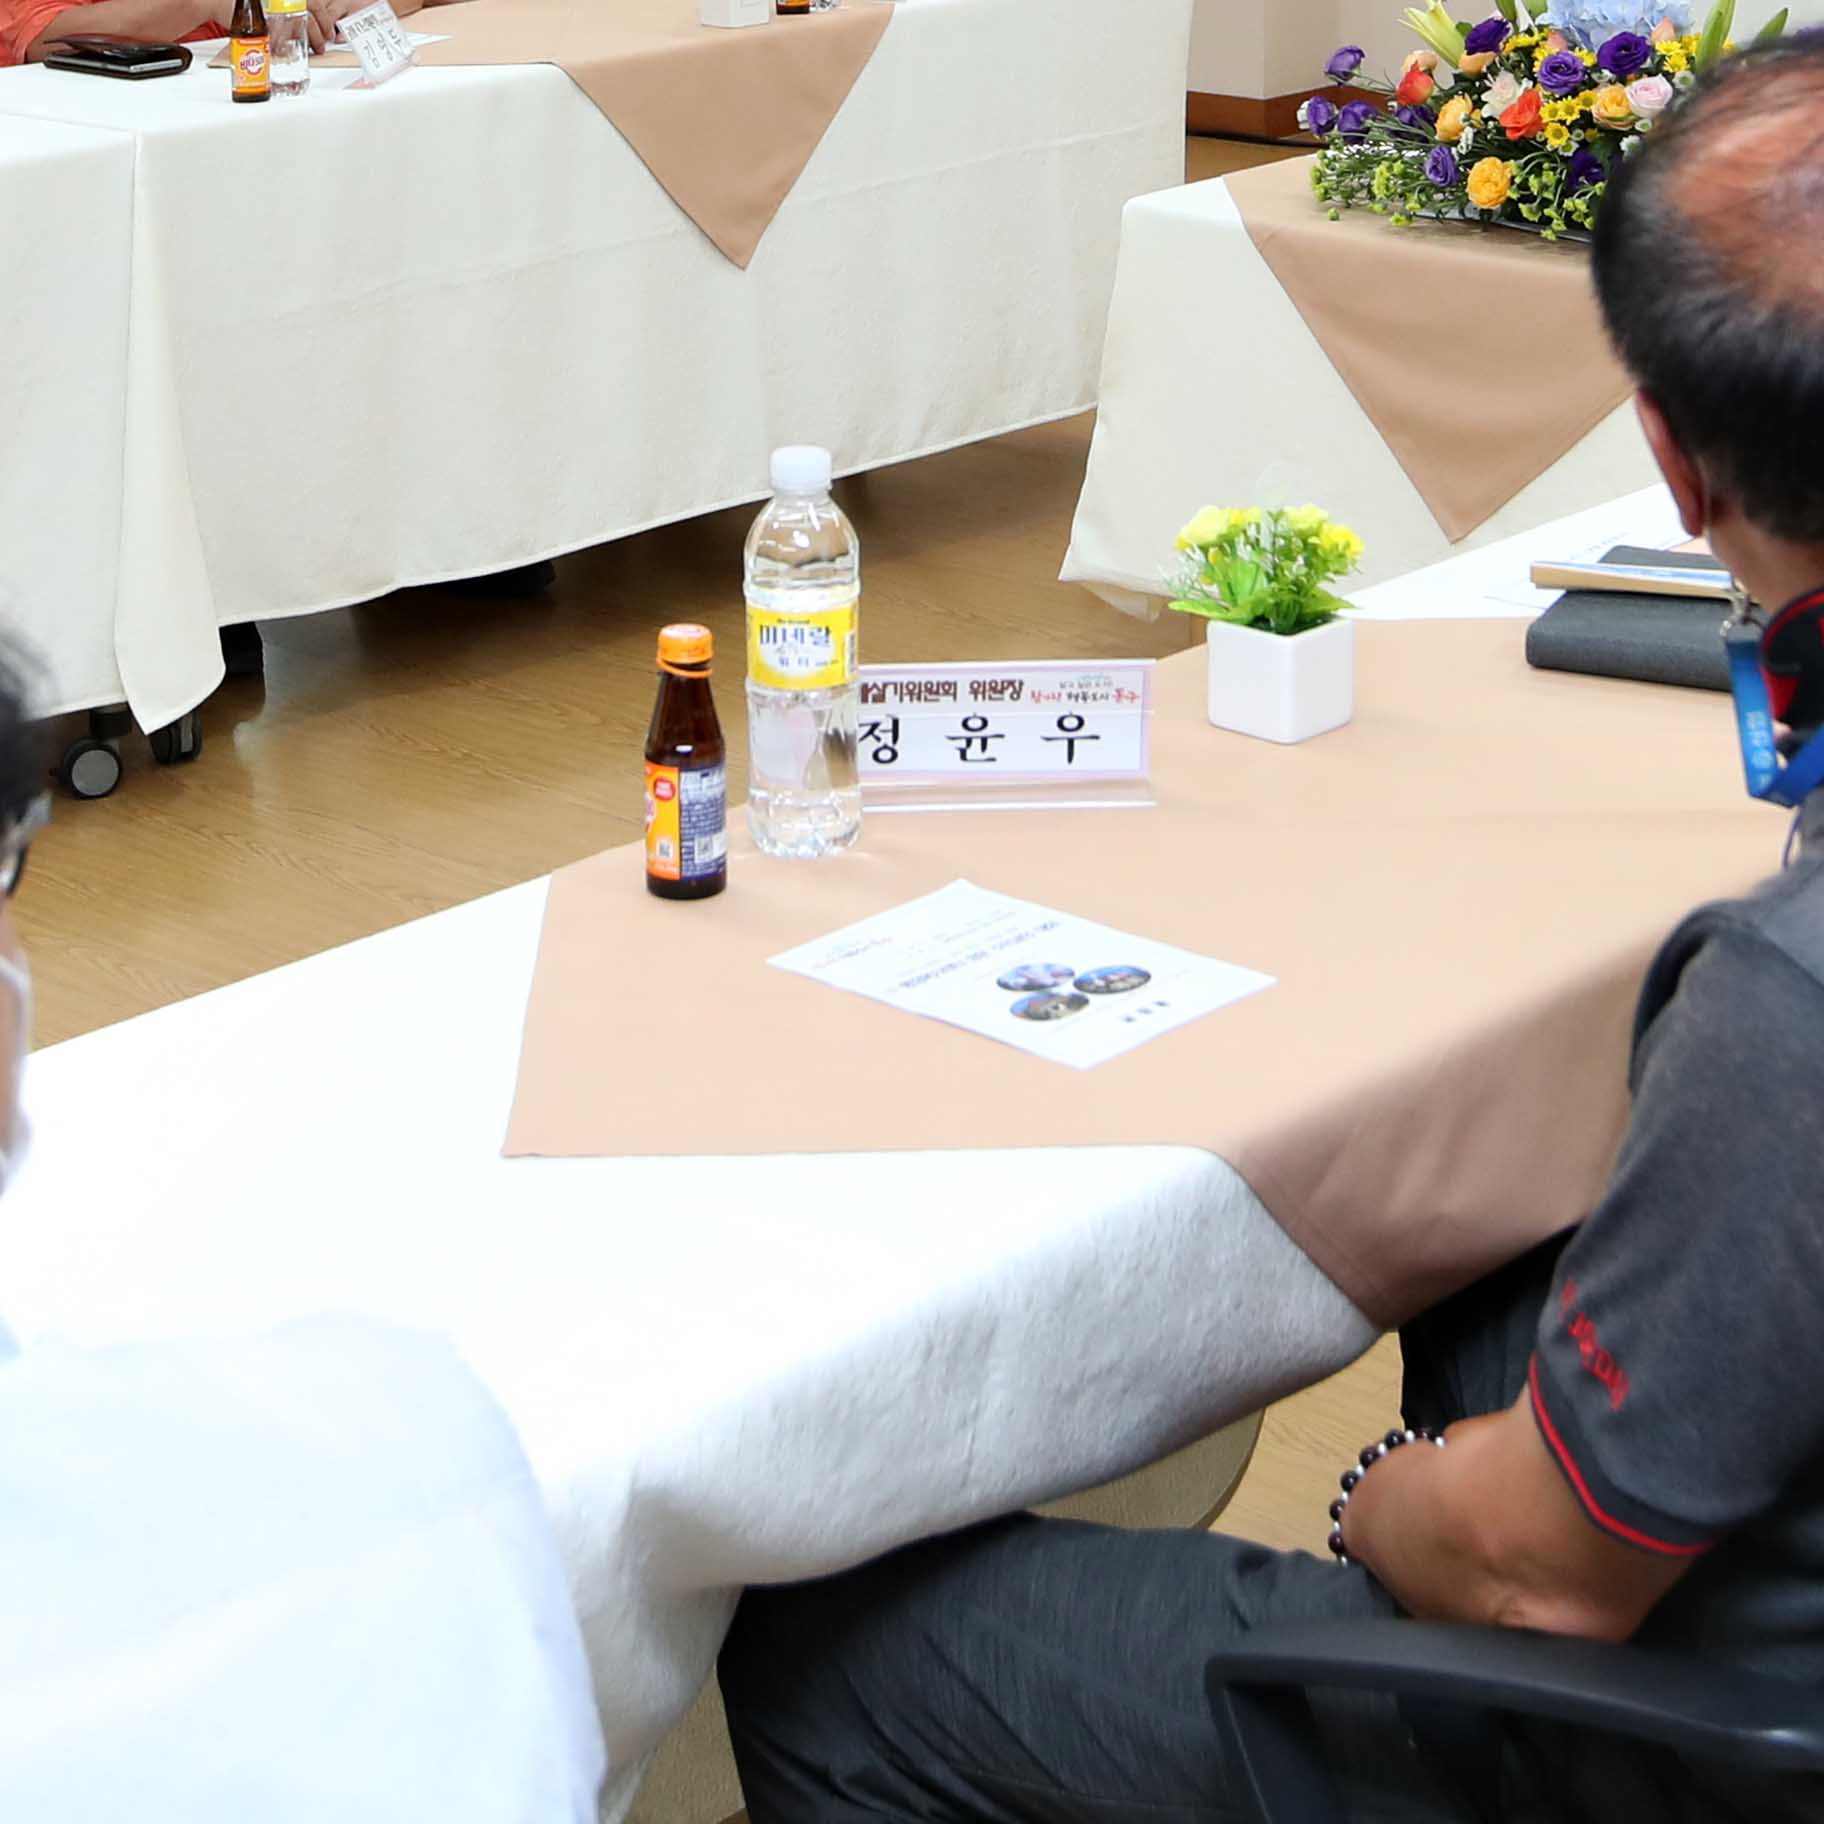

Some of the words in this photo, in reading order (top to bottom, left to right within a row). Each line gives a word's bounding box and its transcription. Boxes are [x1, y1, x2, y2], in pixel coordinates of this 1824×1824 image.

[968, 679, 1024, 704] 위원장
[944, 711, 1006, 764] 윤
[1039, 710, 1102, 766] 우
